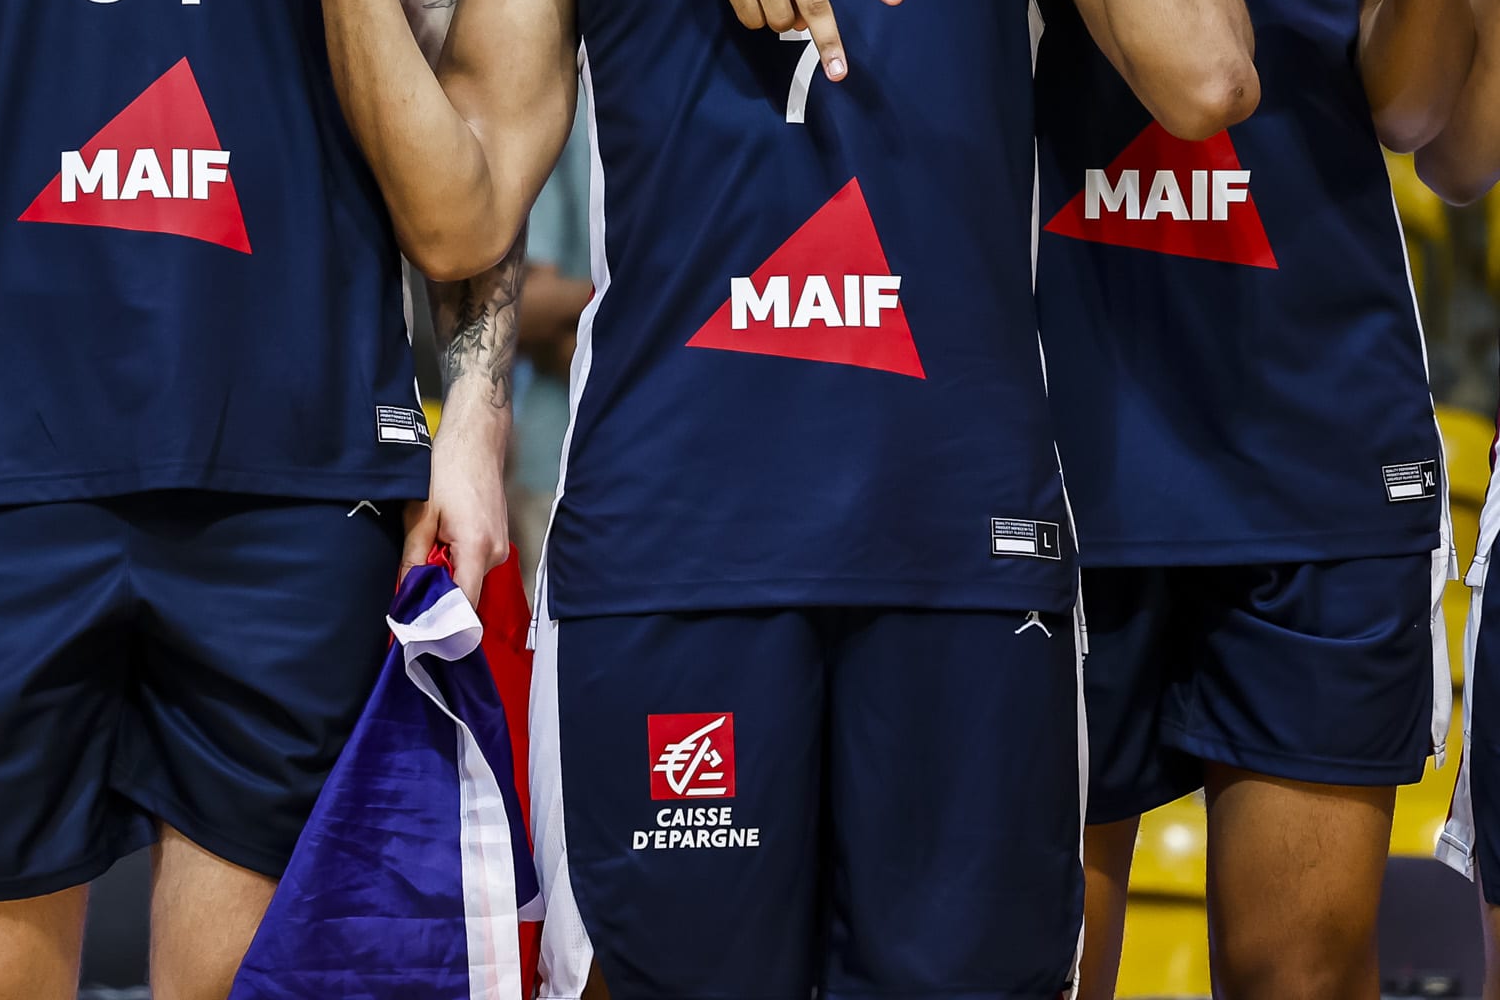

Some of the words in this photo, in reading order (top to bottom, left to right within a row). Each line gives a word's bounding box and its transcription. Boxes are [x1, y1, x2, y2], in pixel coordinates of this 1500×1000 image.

[61, 149, 231, 203] MAIF
[1085, 169, 1251, 221] MAIF
[730, 274, 902, 330] MAIF
[1423, 471, 1436, 488] XL
[1043, 532, 1052, 549] L
[656, 807, 732, 828] CAISSE
[632, 828, 760, 850] D'EPARGNE
